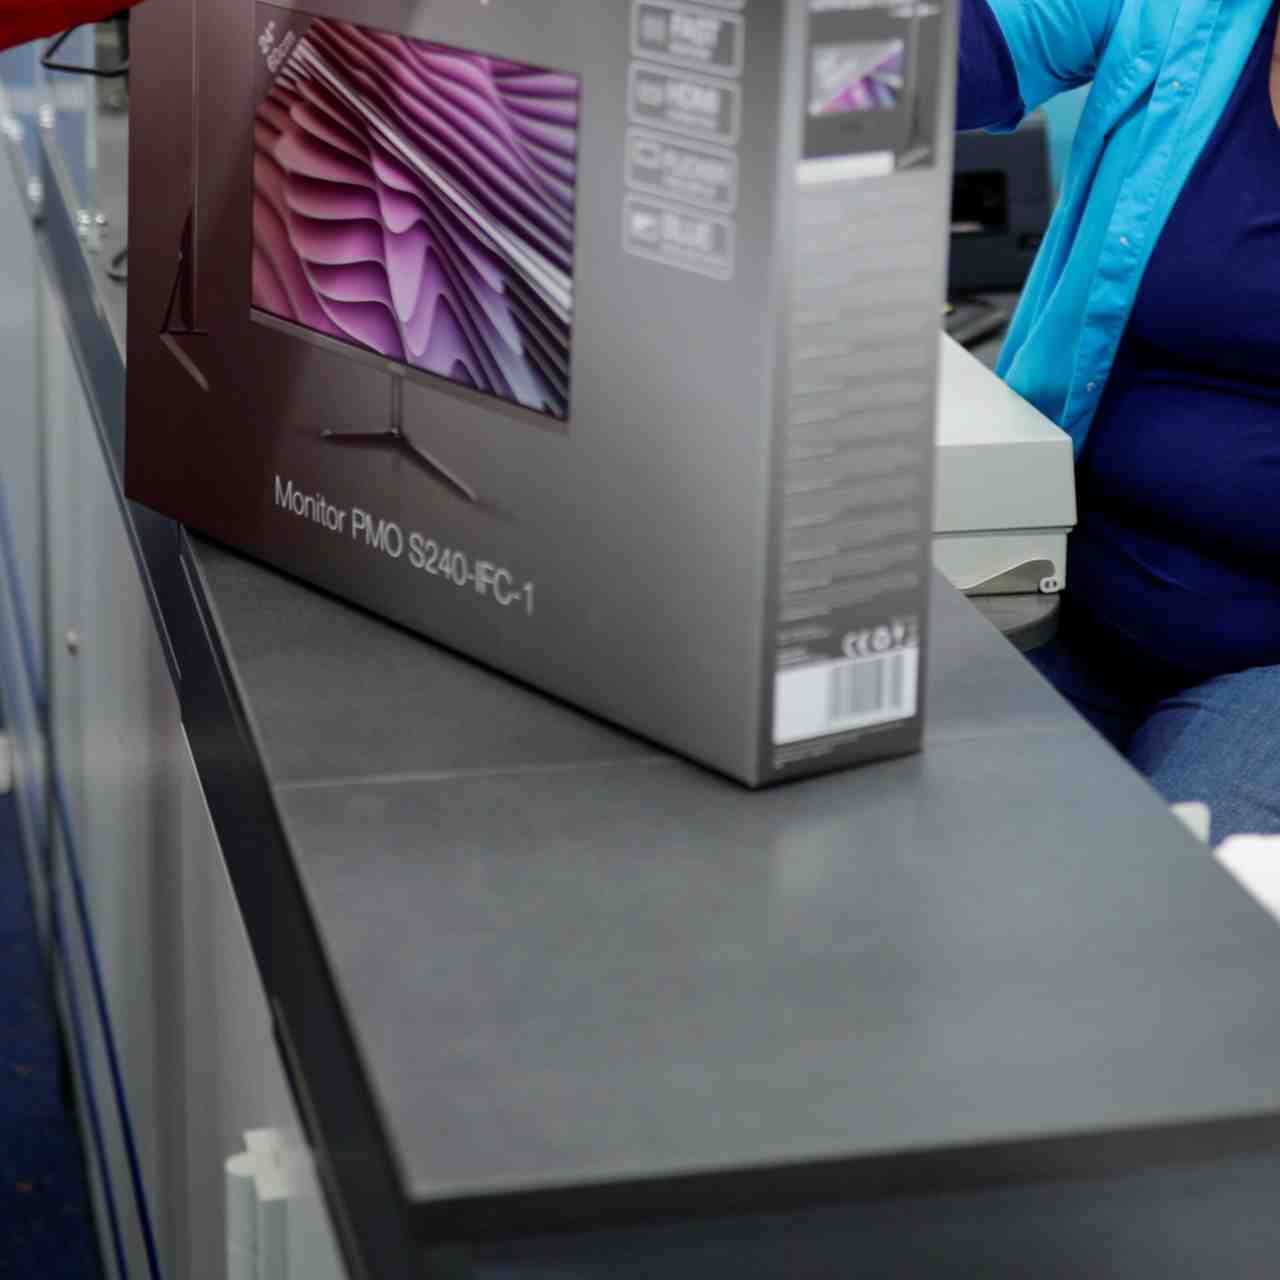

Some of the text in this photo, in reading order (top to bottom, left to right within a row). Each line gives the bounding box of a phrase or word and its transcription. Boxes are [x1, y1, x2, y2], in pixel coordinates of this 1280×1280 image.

[274, 474, 536, 616] Monitor PMO S240-IFC-1
